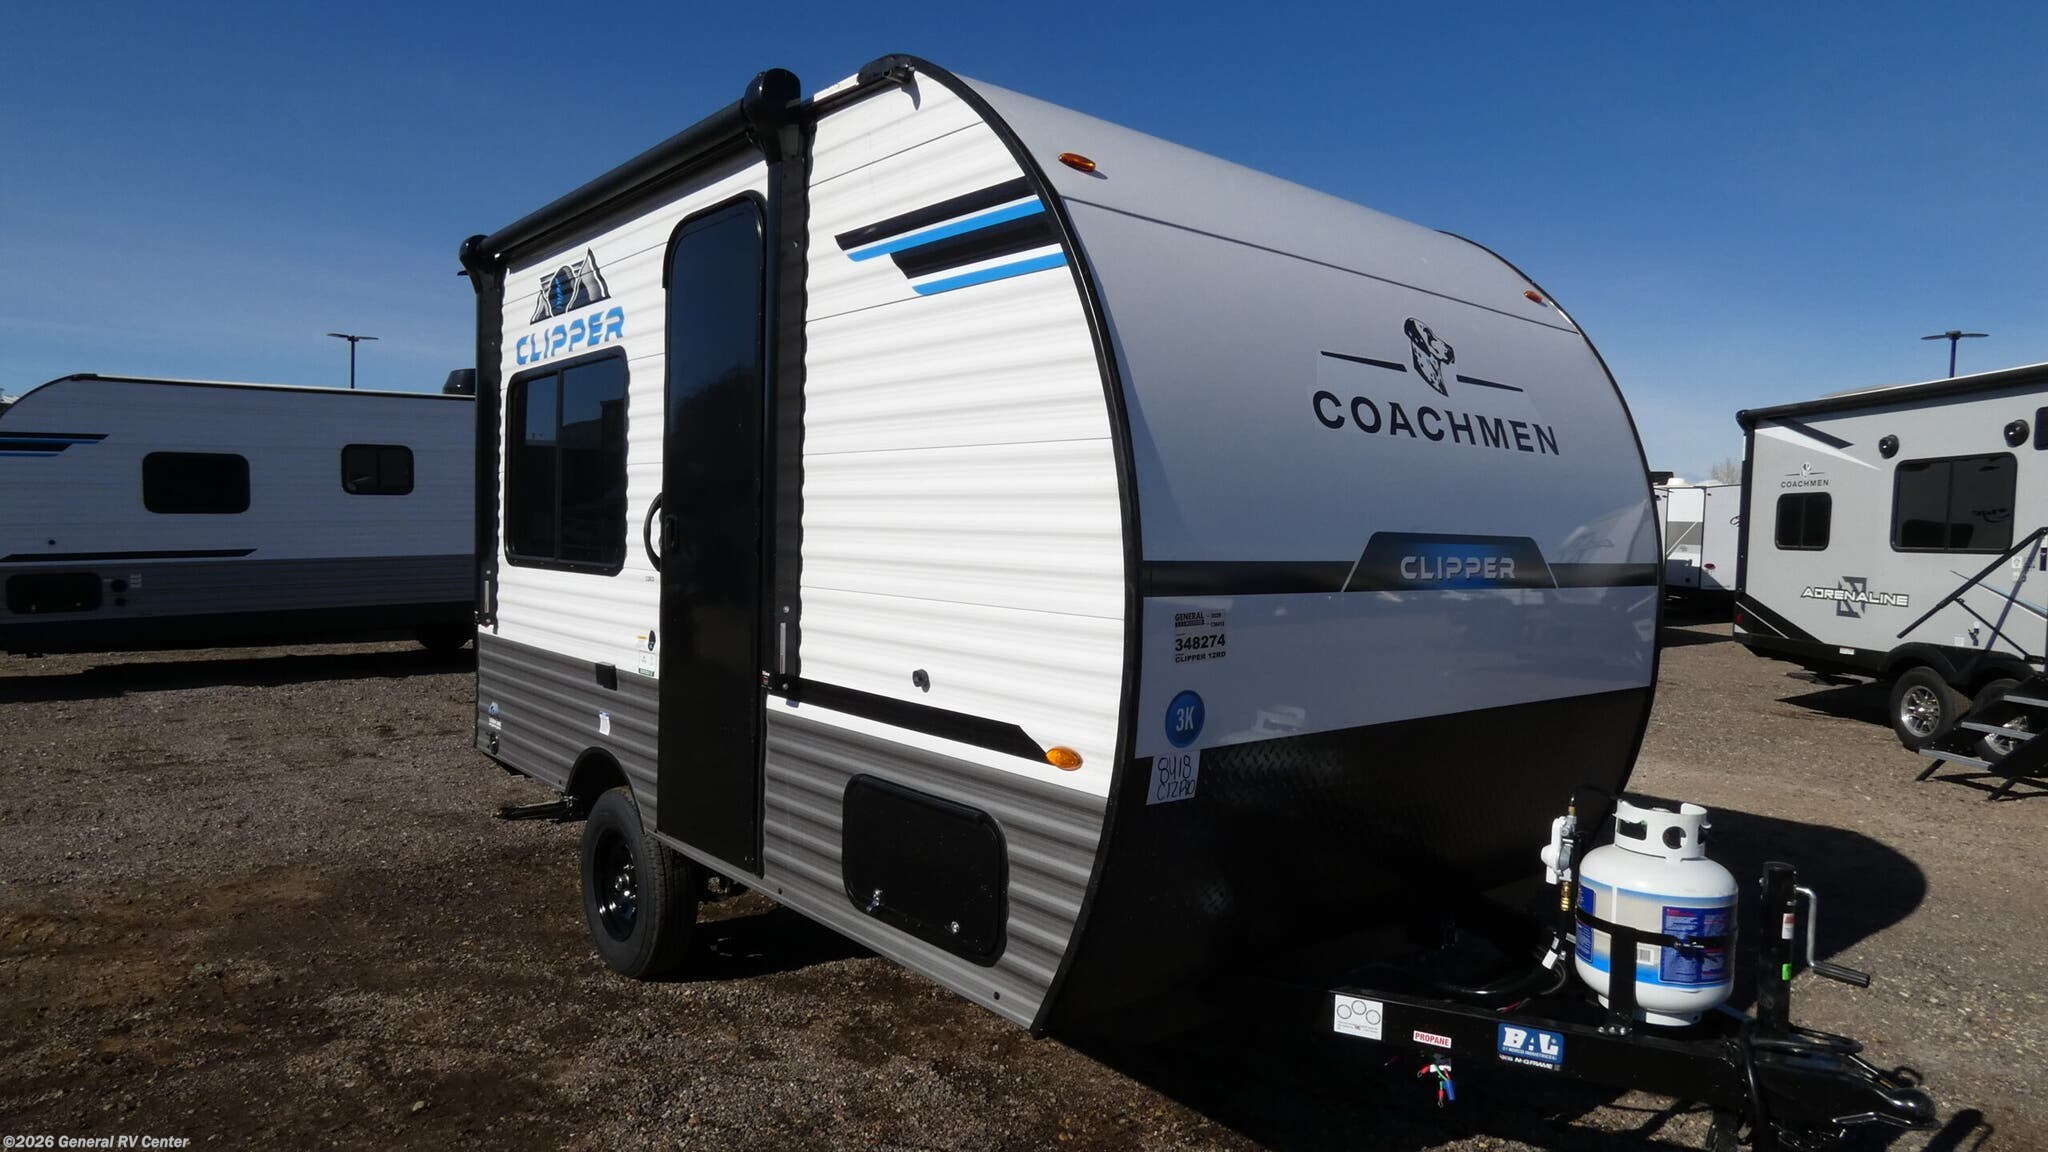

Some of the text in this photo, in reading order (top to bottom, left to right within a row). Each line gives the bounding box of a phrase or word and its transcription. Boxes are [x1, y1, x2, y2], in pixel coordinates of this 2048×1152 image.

[516, 306, 624, 365] CLIPPER
[1312, 390, 1560, 455] COACHMEN
[1780, 479, 1829, 488] COACHMEN
[1400, 556, 1516, 580] CLIPPER
[1801, 586, 1909, 607] ADRENALINE
[1175, 611, 1204, 621] GENERAL
[1175, 633, 1226, 652] 348274
[1176, 705, 1195, 732] 3K
[1158, 755, 1192, 785] 8418
[1415, 1032, 1450, 1046] PROPANE
